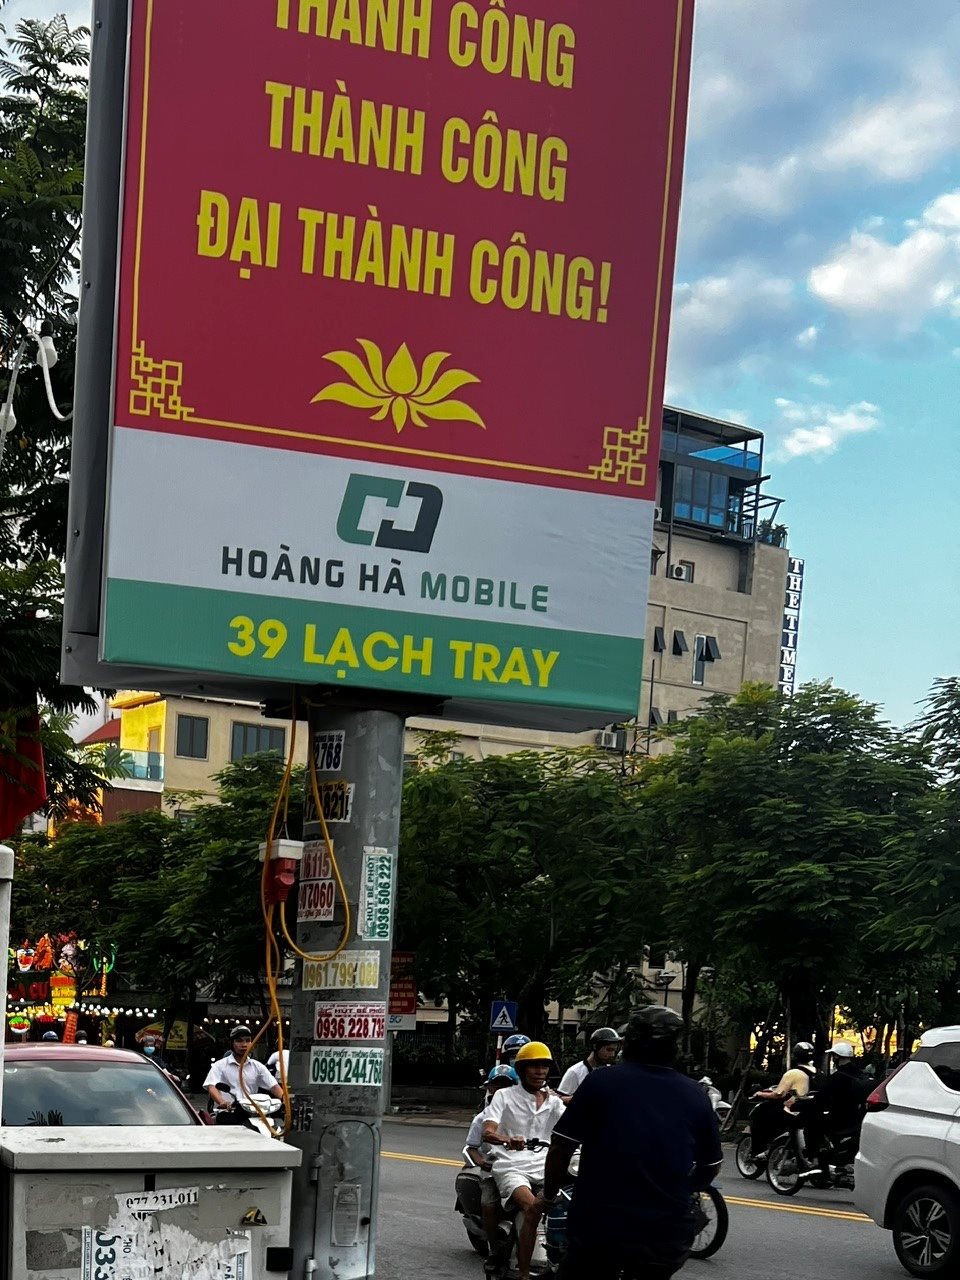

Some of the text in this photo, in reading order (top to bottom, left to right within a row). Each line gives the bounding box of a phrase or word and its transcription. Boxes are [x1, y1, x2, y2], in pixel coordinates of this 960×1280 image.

[449, 0, 575, 88] CÔNG
[266, 80, 567, 201] THÀNH CÔNG
[197, 191, 610, 322] ĐẠI THÀNH CÔNG!
[222, 543, 548, 612] HOÀNG HÀ MOBILE
[788, 558, 803, 609] THE
[229, 616, 558, 686] 39 LẠCH TRAY
